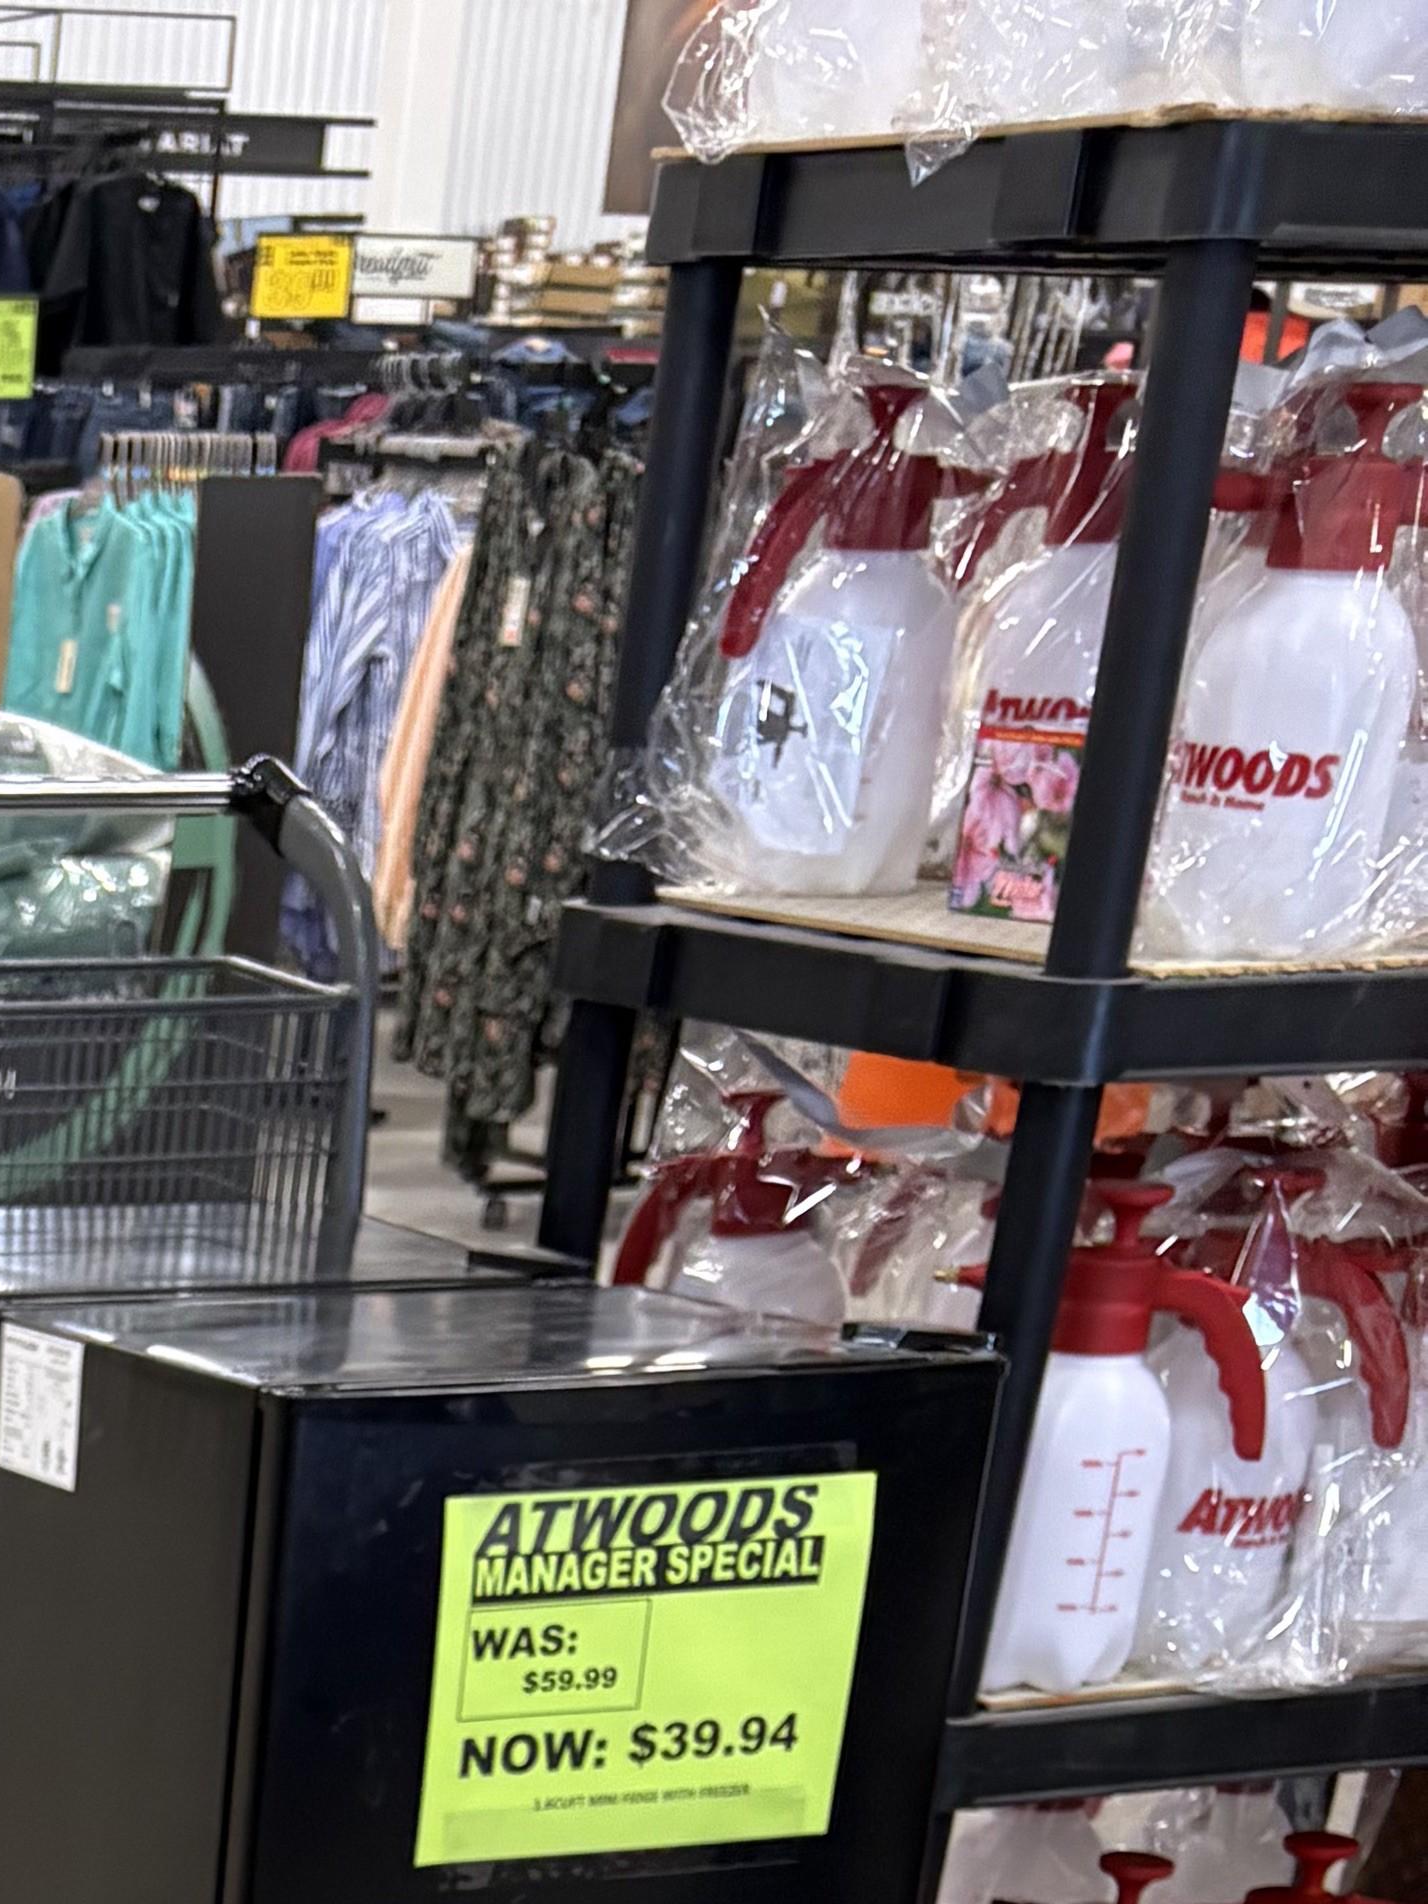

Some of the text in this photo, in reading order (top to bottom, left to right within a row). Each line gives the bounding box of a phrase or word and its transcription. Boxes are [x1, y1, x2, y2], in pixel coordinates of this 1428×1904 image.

[475, 1484, 820, 1557] ATWOODS
[475, 1538, 821, 1597] MANAGER SPECIAL
[472, 1624, 579, 1661] WAS:
[523, 1667, 618, 1694] $59.99
[459, 1713, 798, 1778] NOW: $39.94
